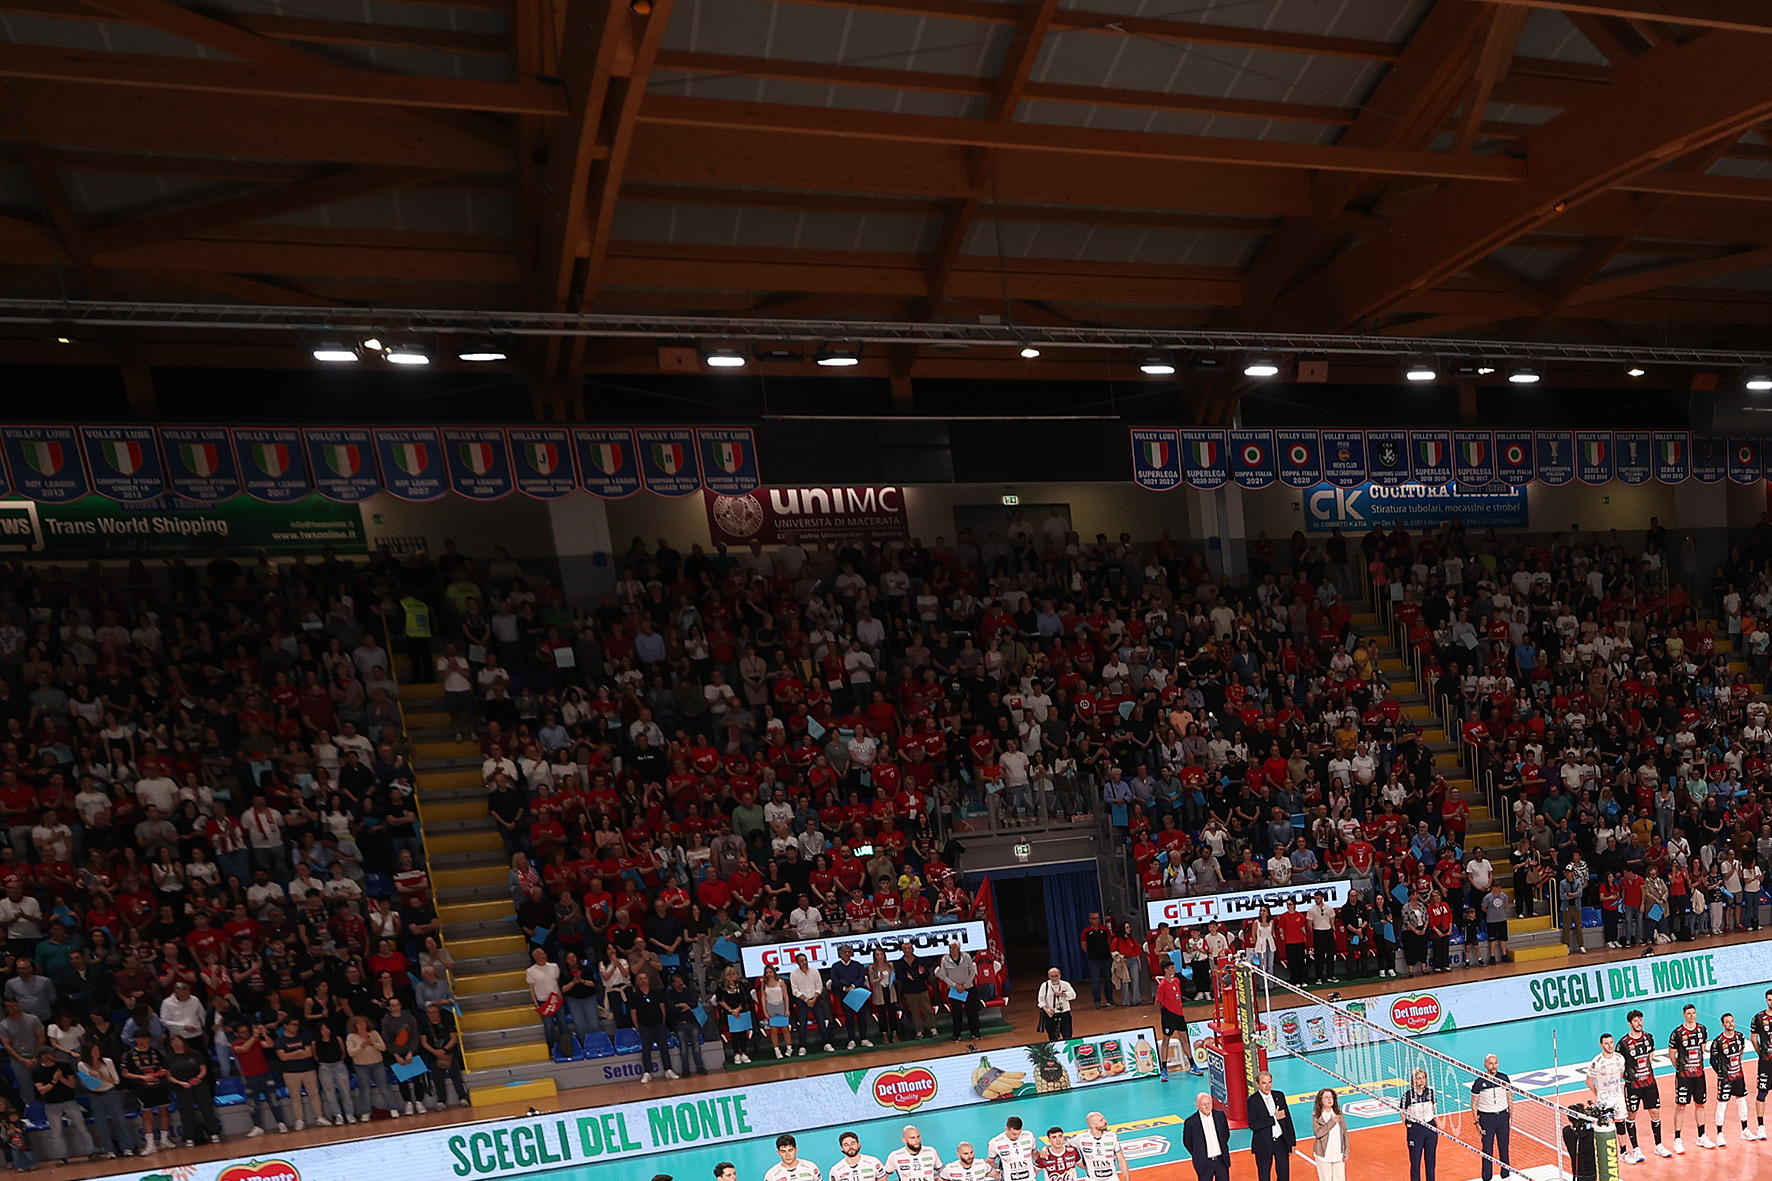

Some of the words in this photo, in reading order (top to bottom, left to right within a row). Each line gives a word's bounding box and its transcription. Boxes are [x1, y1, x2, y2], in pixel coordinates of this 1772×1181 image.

[1134, 432, 1158, 440] VOLLEY
[1159, 432, 1175, 440] LUBE
[1183, 432, 1206, 440] VOLLEY
[1207, 432, 1223, 440] LUBE
[1231, 432, 1254, 440] VOLLEY
[1255, 432, 1271, 440] LUBE
[1138, 470, 1178, 478] SUPERLEGA
[1187, 469, 1226, 478] SUPERLEGA
[1415, 468, 1450, 476] SUPERLEGA
[1246, 477, 1263, 485] 2021
[1369, 484, 1450, 499] CUCITURA
[1309, 488, 1365, 520] CK
[1371, 503, 1407, 514] Stiratura
[1409, 503, 1444, 514] tubolari,
[1445, 502, 1485, 512] mocassini
[1492, 502, 1520, 512] strobel
[45, 517, 97, 535] Trans
[97, 516, 150, 534] World
[152, 516, 229, 537] Shipping
[774, 516, 834, 529] UNIVERSITÀ
[836, 517, 846, 527] DI
[847, 516, 900, 527] MACERATA
[1164, 900, 1215, 919] GTT
[762, 944, 822, 966] GTT
[1529, 970, 1605, 1012] SCEGLI
[1608, 966, 1648, 1000] DEL
[1651, 954, 1717, 993] MONTE
[603, 1061, 659, 1079] Settoe
[878, 1083, 896, 1097] Del
[896, 1078, 933, 1093] Monte
[448, 1120, 573, 1177] SCEGLI
[577, 1112, 642, 1158] DEL
[647, 1094, 752, 1148] MONTE
